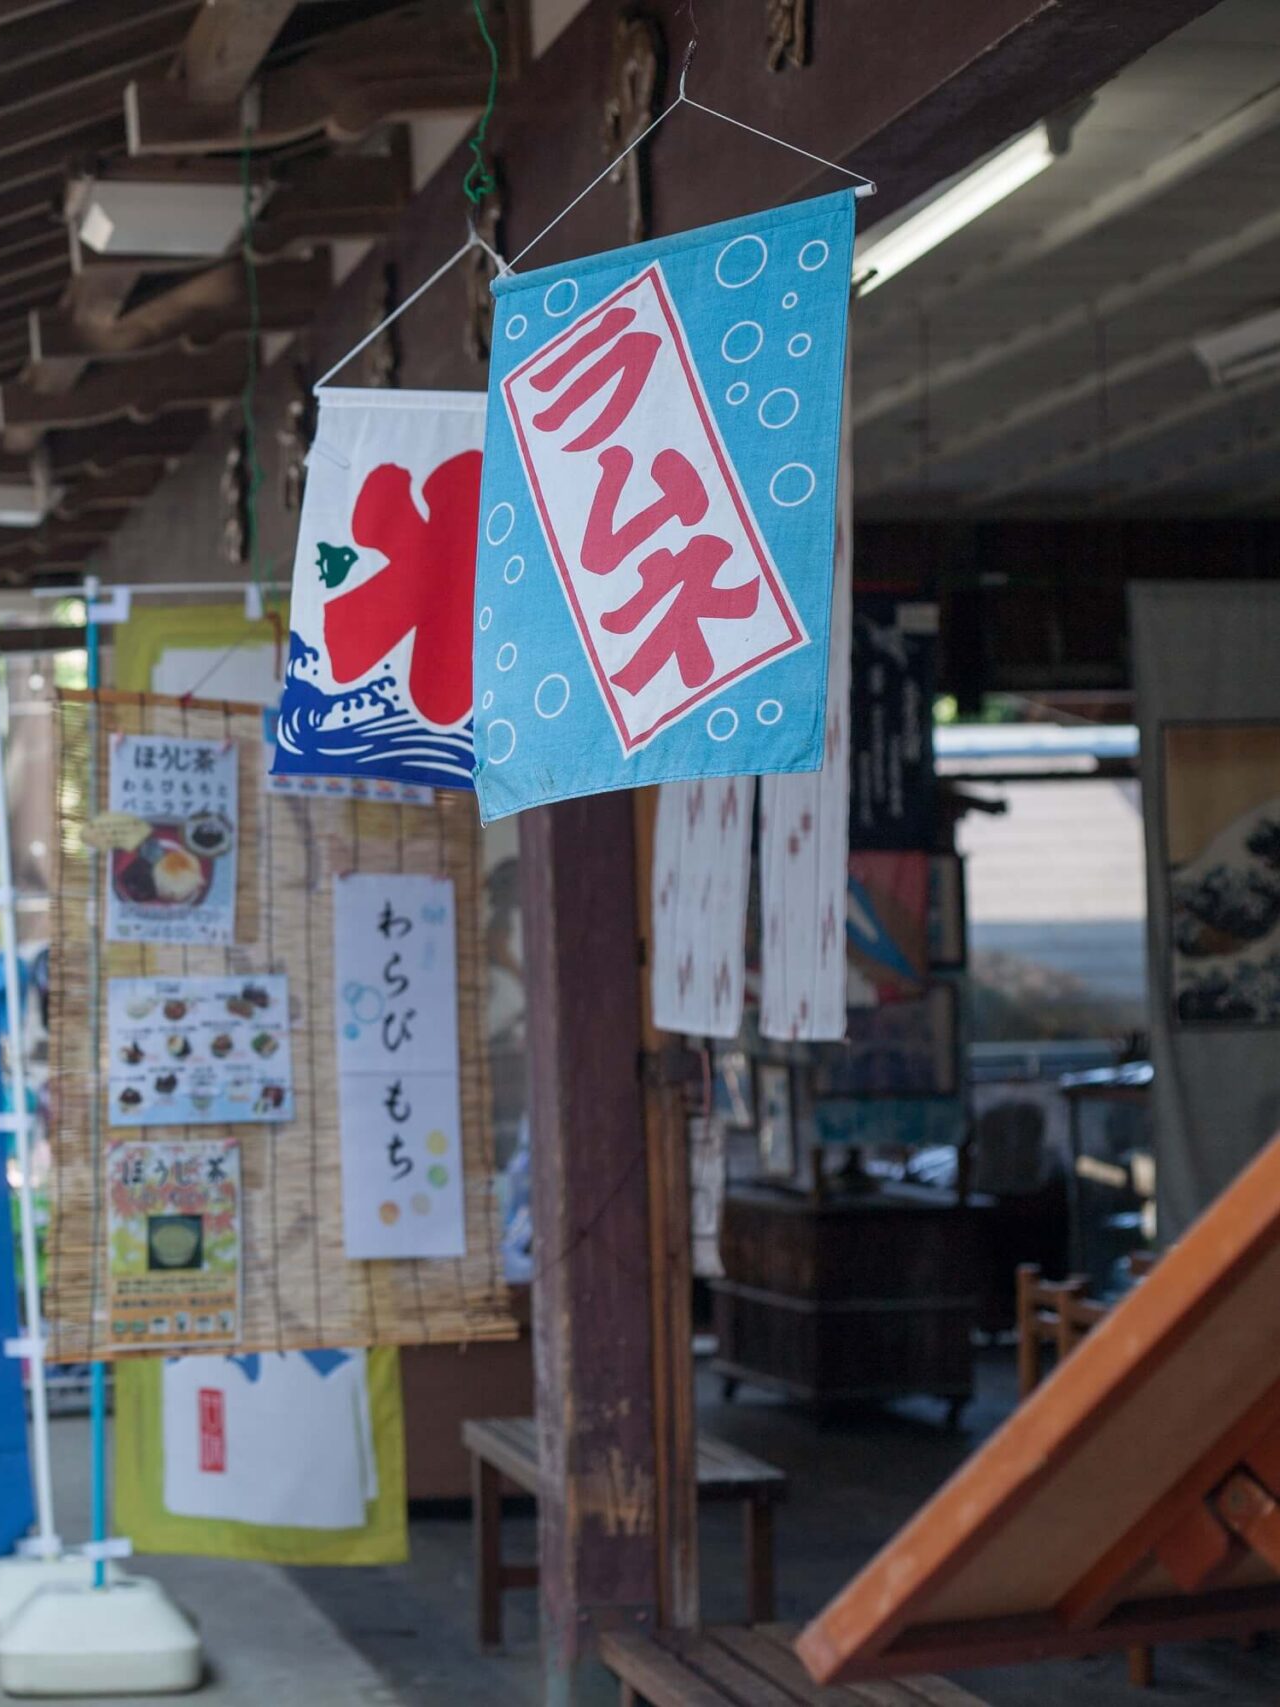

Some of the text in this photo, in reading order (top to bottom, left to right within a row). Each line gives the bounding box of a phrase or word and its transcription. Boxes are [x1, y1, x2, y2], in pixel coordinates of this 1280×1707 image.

[529, 307, 761, 696] ラムネ
[134, 744, 217, 774] ほうじ茶
[376, 900, 414, 1181] わらびもち
